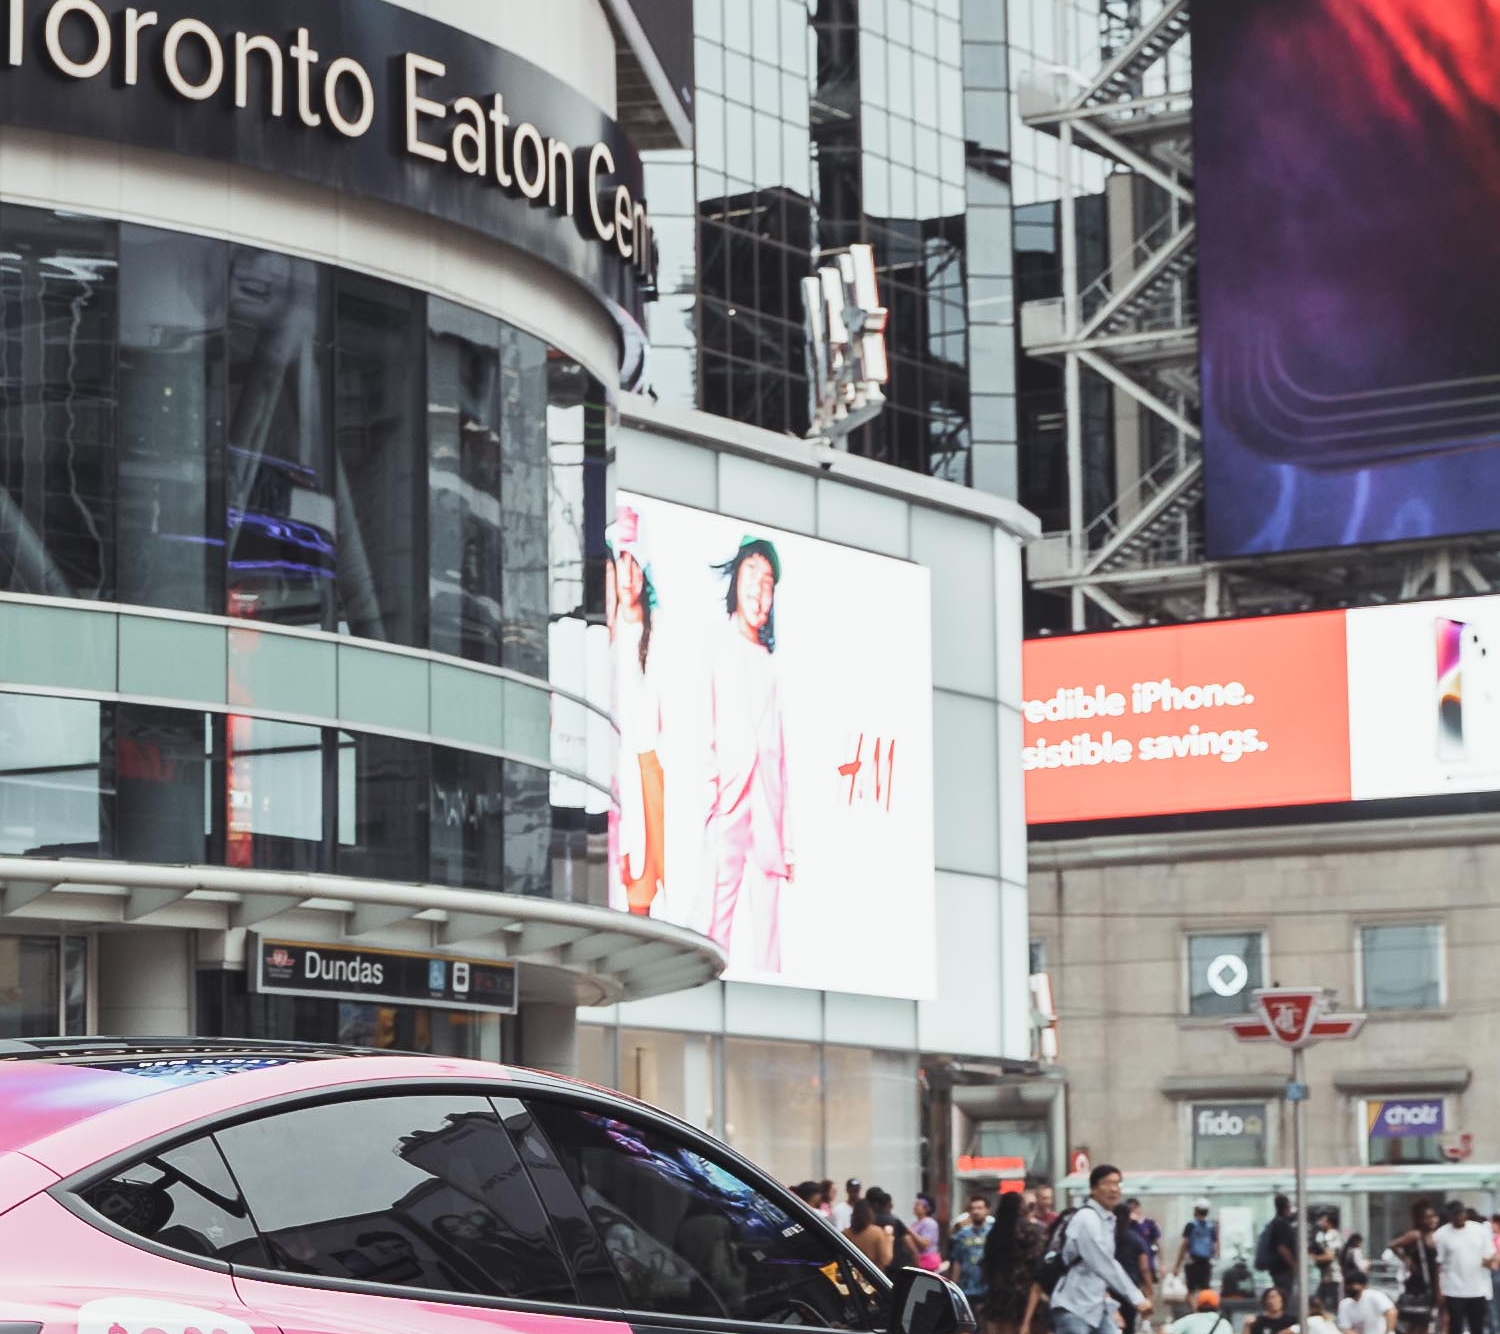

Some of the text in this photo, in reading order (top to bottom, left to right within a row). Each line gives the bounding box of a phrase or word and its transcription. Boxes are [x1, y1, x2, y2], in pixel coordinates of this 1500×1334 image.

[403, 51, 574, 217] Eaton
[588, 141, 653, 283] Cen
[1132, 678, 1255, 714] iPhone.
[1021, 724, 1268, 770] sistible savings.
[304, 951, 384, 985] Dundas
[1199, 1110, 1244, 1135] fido
[1384, 1105, 1439, 1125] chatr
